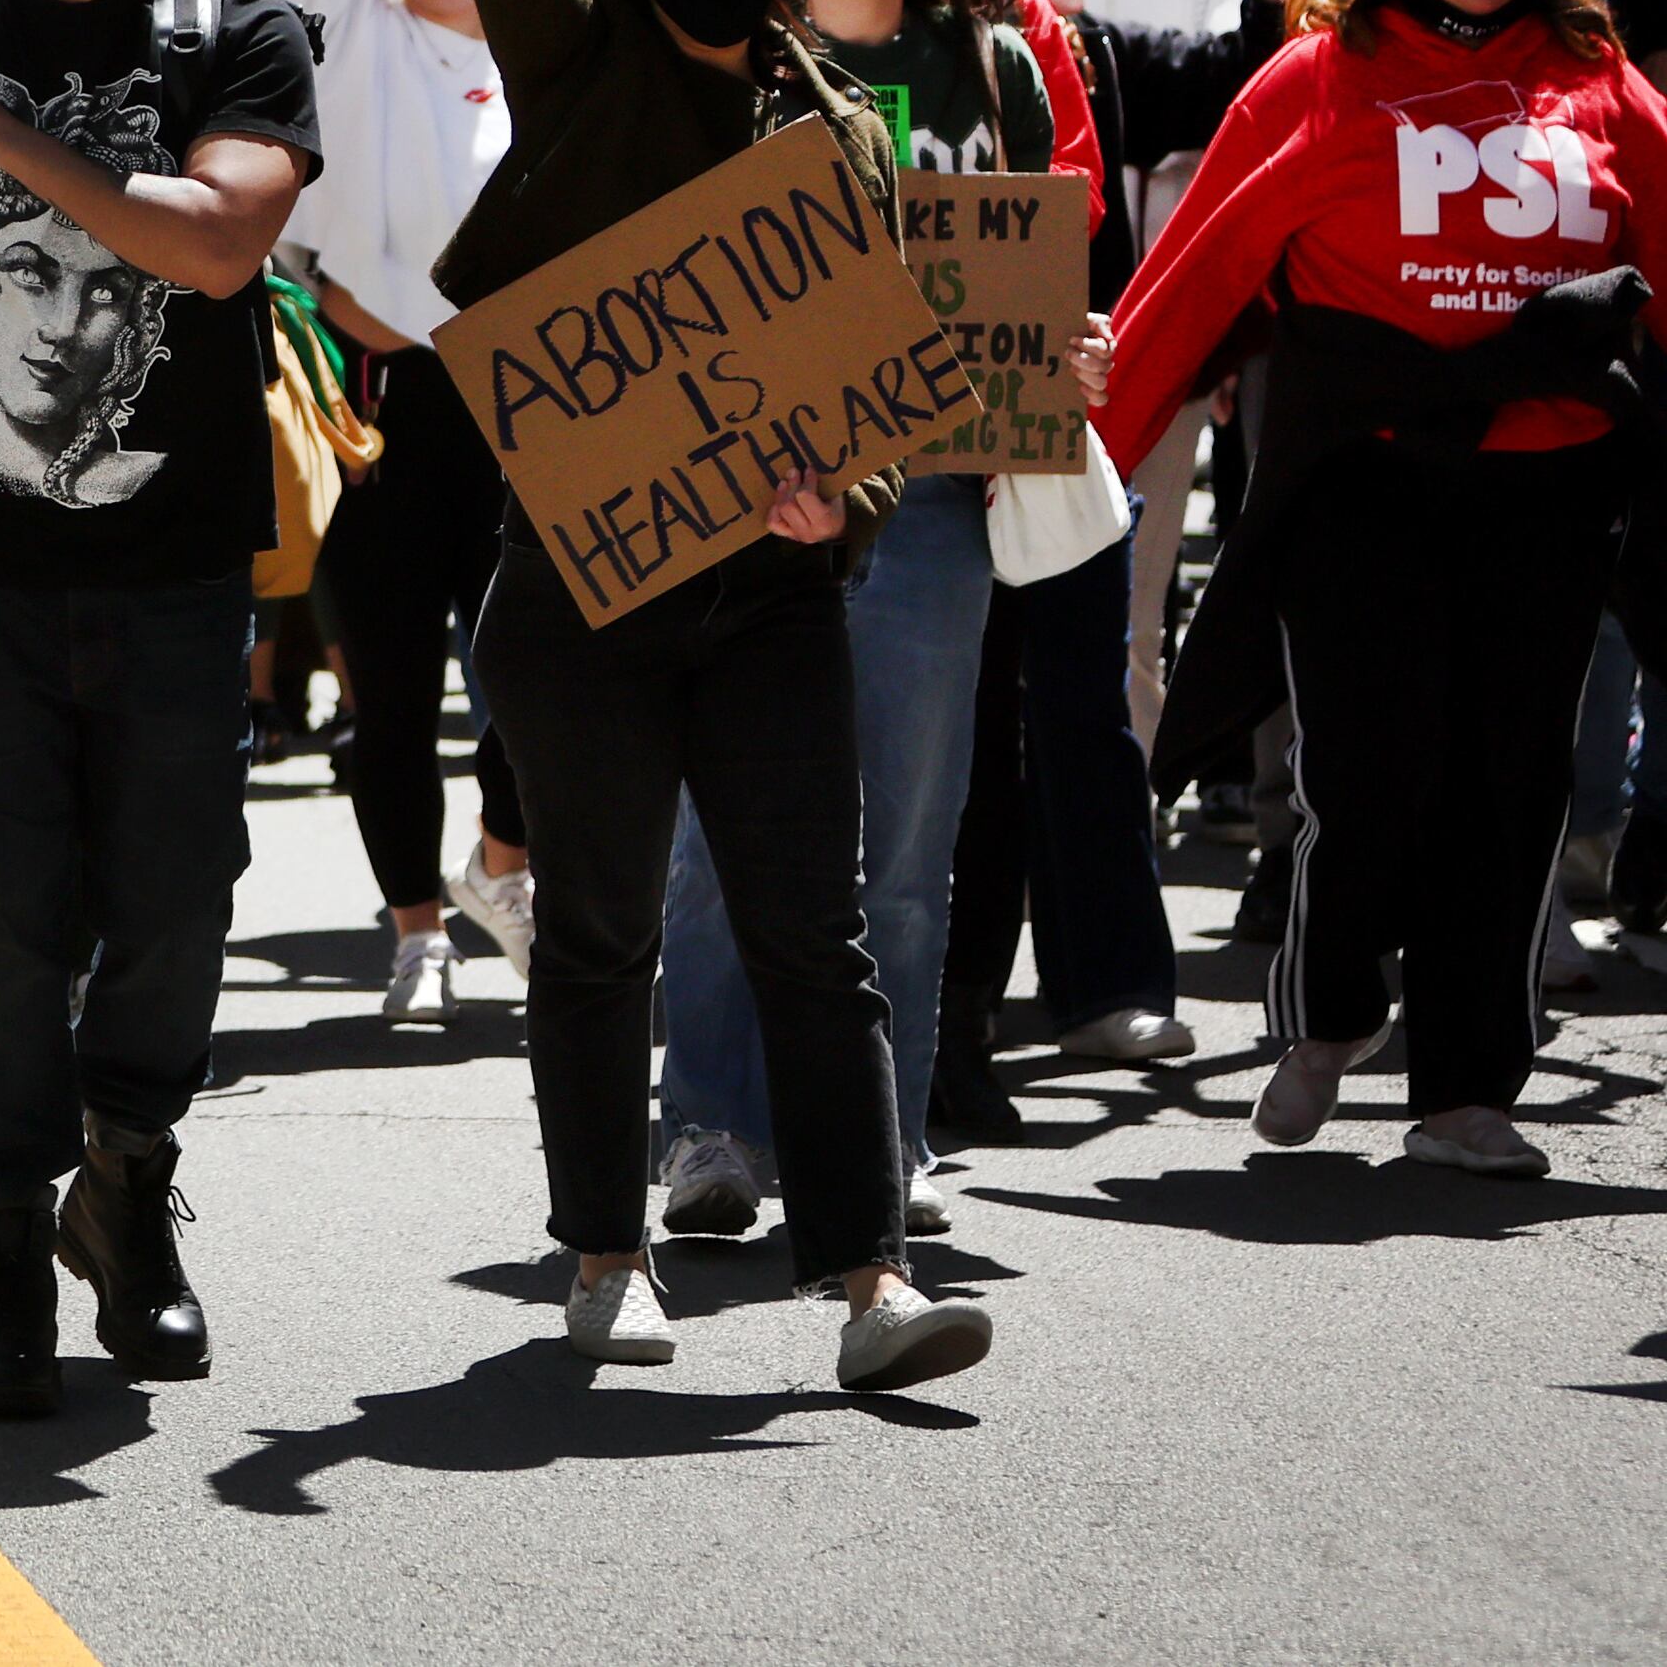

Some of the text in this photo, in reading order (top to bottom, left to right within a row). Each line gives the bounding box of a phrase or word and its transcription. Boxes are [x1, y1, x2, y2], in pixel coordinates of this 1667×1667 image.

[1396, 123, 1608, 244] PSL
[978, 197, 1041, 241] MY
[493, 159, 872, 453] ABORTION
[1401, 262, 1471, 286] Party
[1476, 263, 1509, 284] for
[1430, 290, 1477, 311] and
[676, 350, 767, 435] IS
[550, 330, 976, 609] HEALTHCARE
[1010, 410, 1086, 461] IT?
